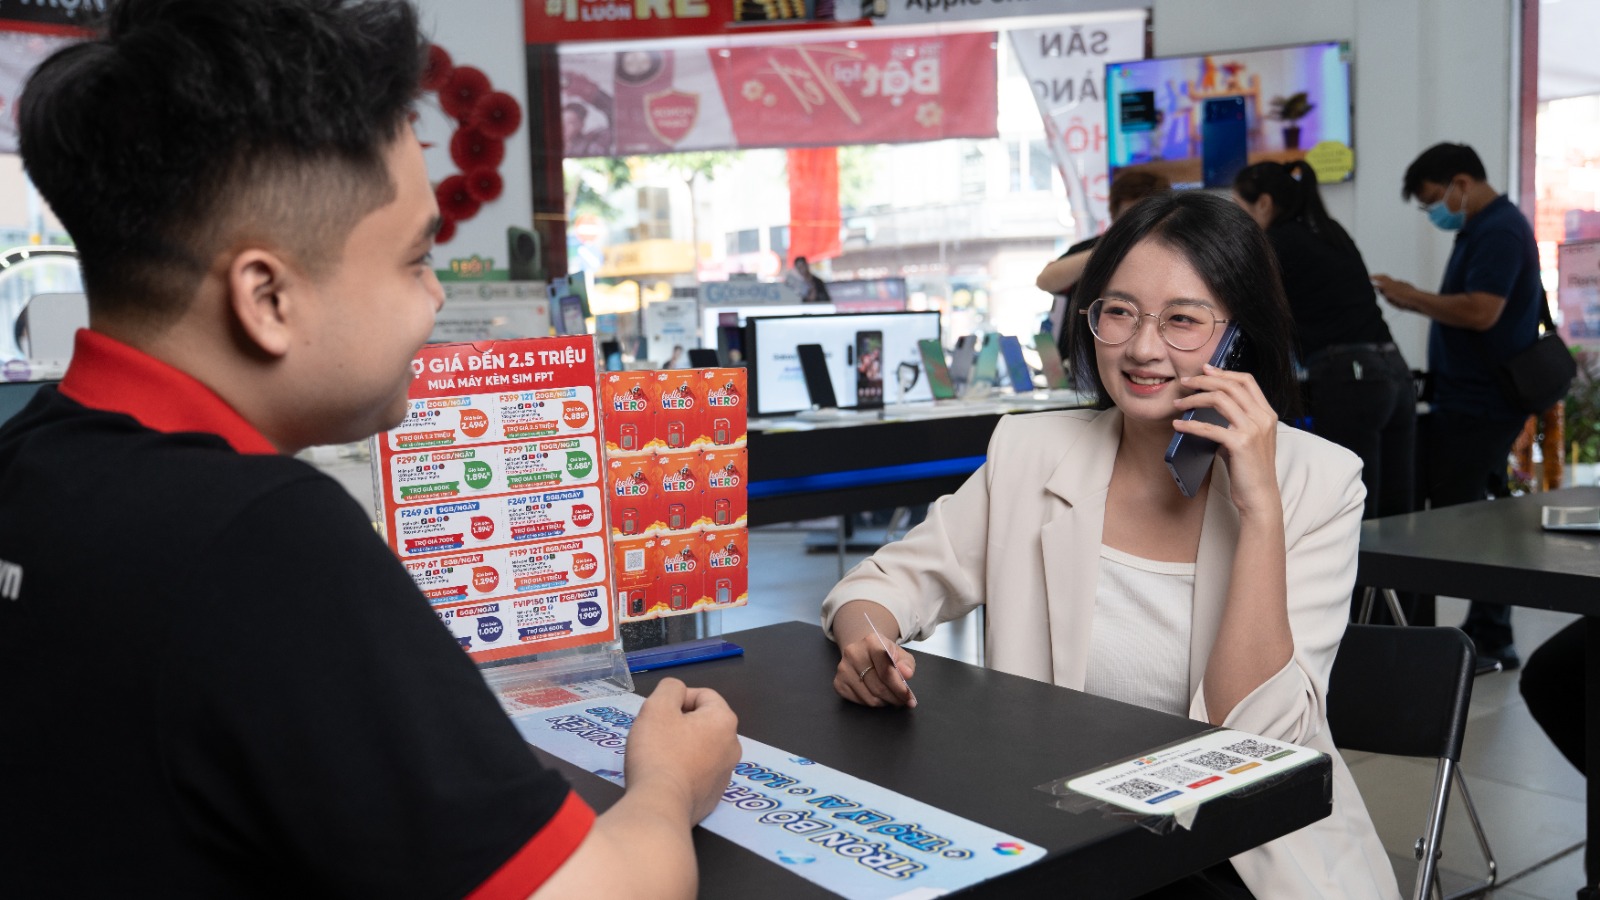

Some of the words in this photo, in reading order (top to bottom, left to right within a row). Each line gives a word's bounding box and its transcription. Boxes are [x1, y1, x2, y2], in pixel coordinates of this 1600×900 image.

[429, 353, 464, 373] GIÁ
[468, 350, 506, 371] ĐẾN
[509, 354, 535, 368] 2.5
[538, 346, 587, 369] TRIỆU
[428, 379, 453, 391] MUA
[458, 374, 483, 388] MÁY
[485, 373, 510, 386] KÈM
[512, 373, 533, 384] SIM
[535, 371, 554, 382] FPT
[500, 394, 519, 402] F399
[521, 393, 534, 401] 12T
[662, 397, 694, 409] HERO
[708, 395, 740, 406] HERO
[415, 401, 425, 410] 6T
[614, 399, 647, 411] HERO
[504, 446, 523, 454] F299
[525, 444, 537, 452] 12T
[397, 456, 417, 464] F299
[663, 479, 695, 492] HERO
[709, 475, 740, 488] HERO
[616, 484, 648, 496] HERO
[508, 497, 526, 505] F249
[401, 509, 421, 518] F249
[509, 549, 527, 558] F199
[406, 562, 426, 570] F199
[427, 560, 438, 568] 6T
[665, 560, 696, 573] HERO
[710, 555, 740, 568] HERO
[513, 597, 544, 608] FVIP150
[445, 611, 454, 619] 6T
[805, 794, 863, 810] AI
[757, 810, 837, 834] BỘ
[865, 823, 953, 853] TRỢ
[808, 831, 928, 880] TRỌN
